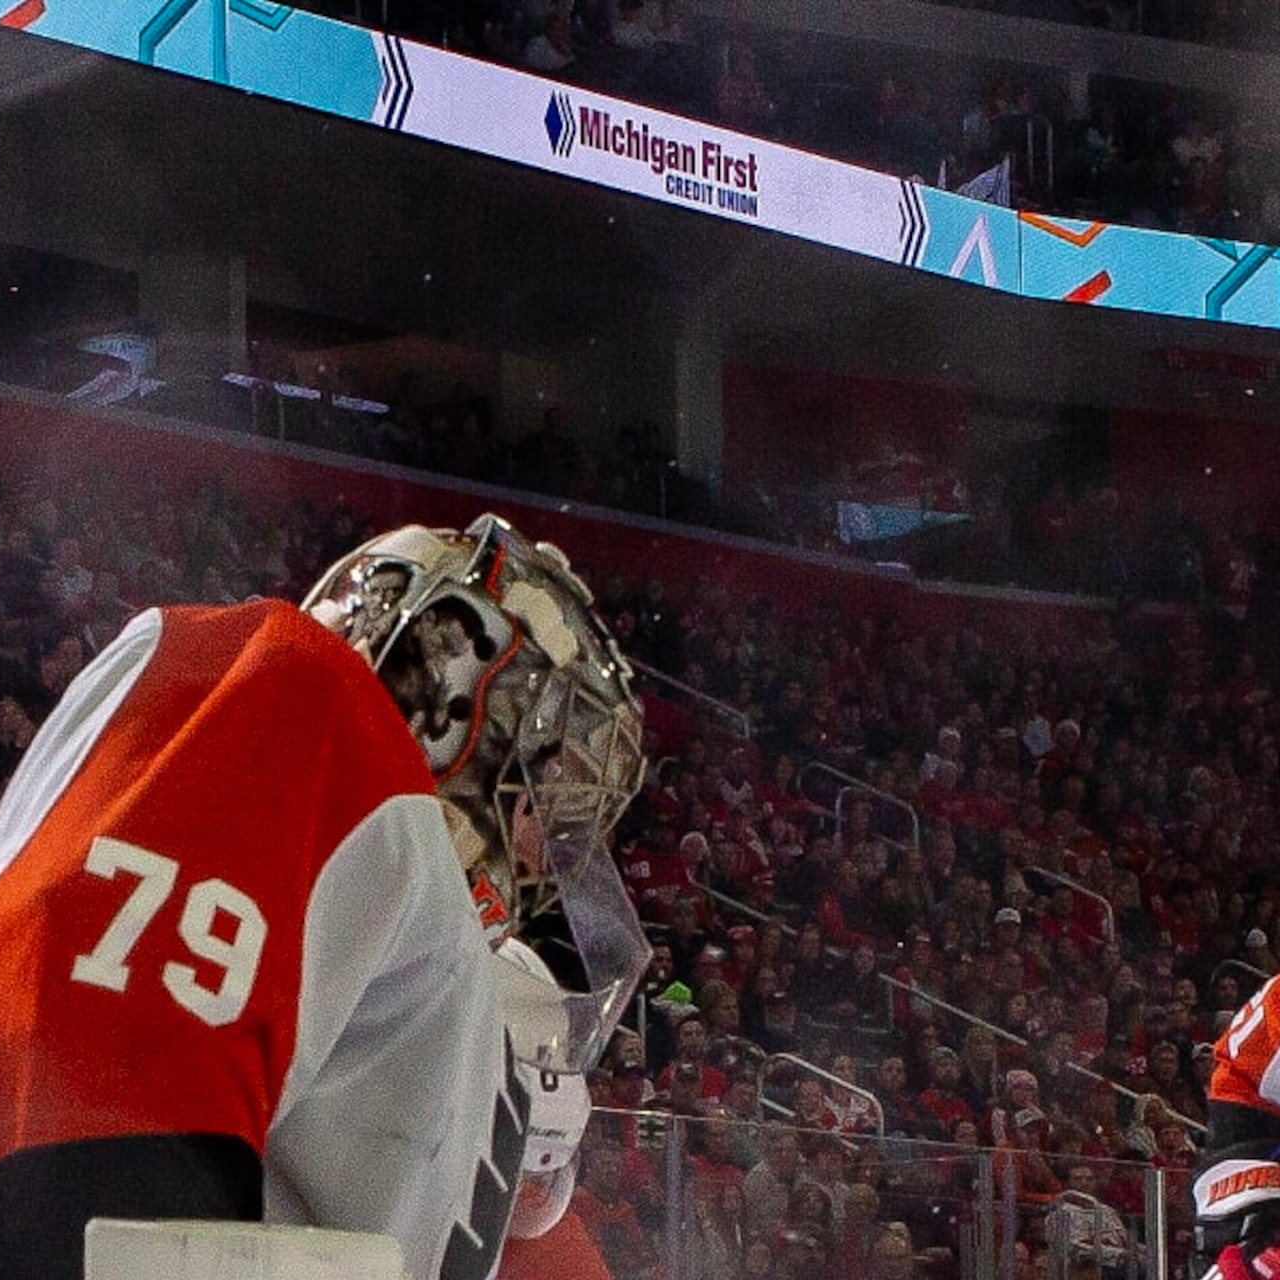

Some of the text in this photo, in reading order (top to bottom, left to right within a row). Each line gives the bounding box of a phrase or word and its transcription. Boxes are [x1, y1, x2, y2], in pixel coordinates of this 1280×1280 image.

[578, 105, 759, 192] Michigan First
[665, 174, 759, 218] CREDIT UNION
[70, 834, 269, 1029] 79
